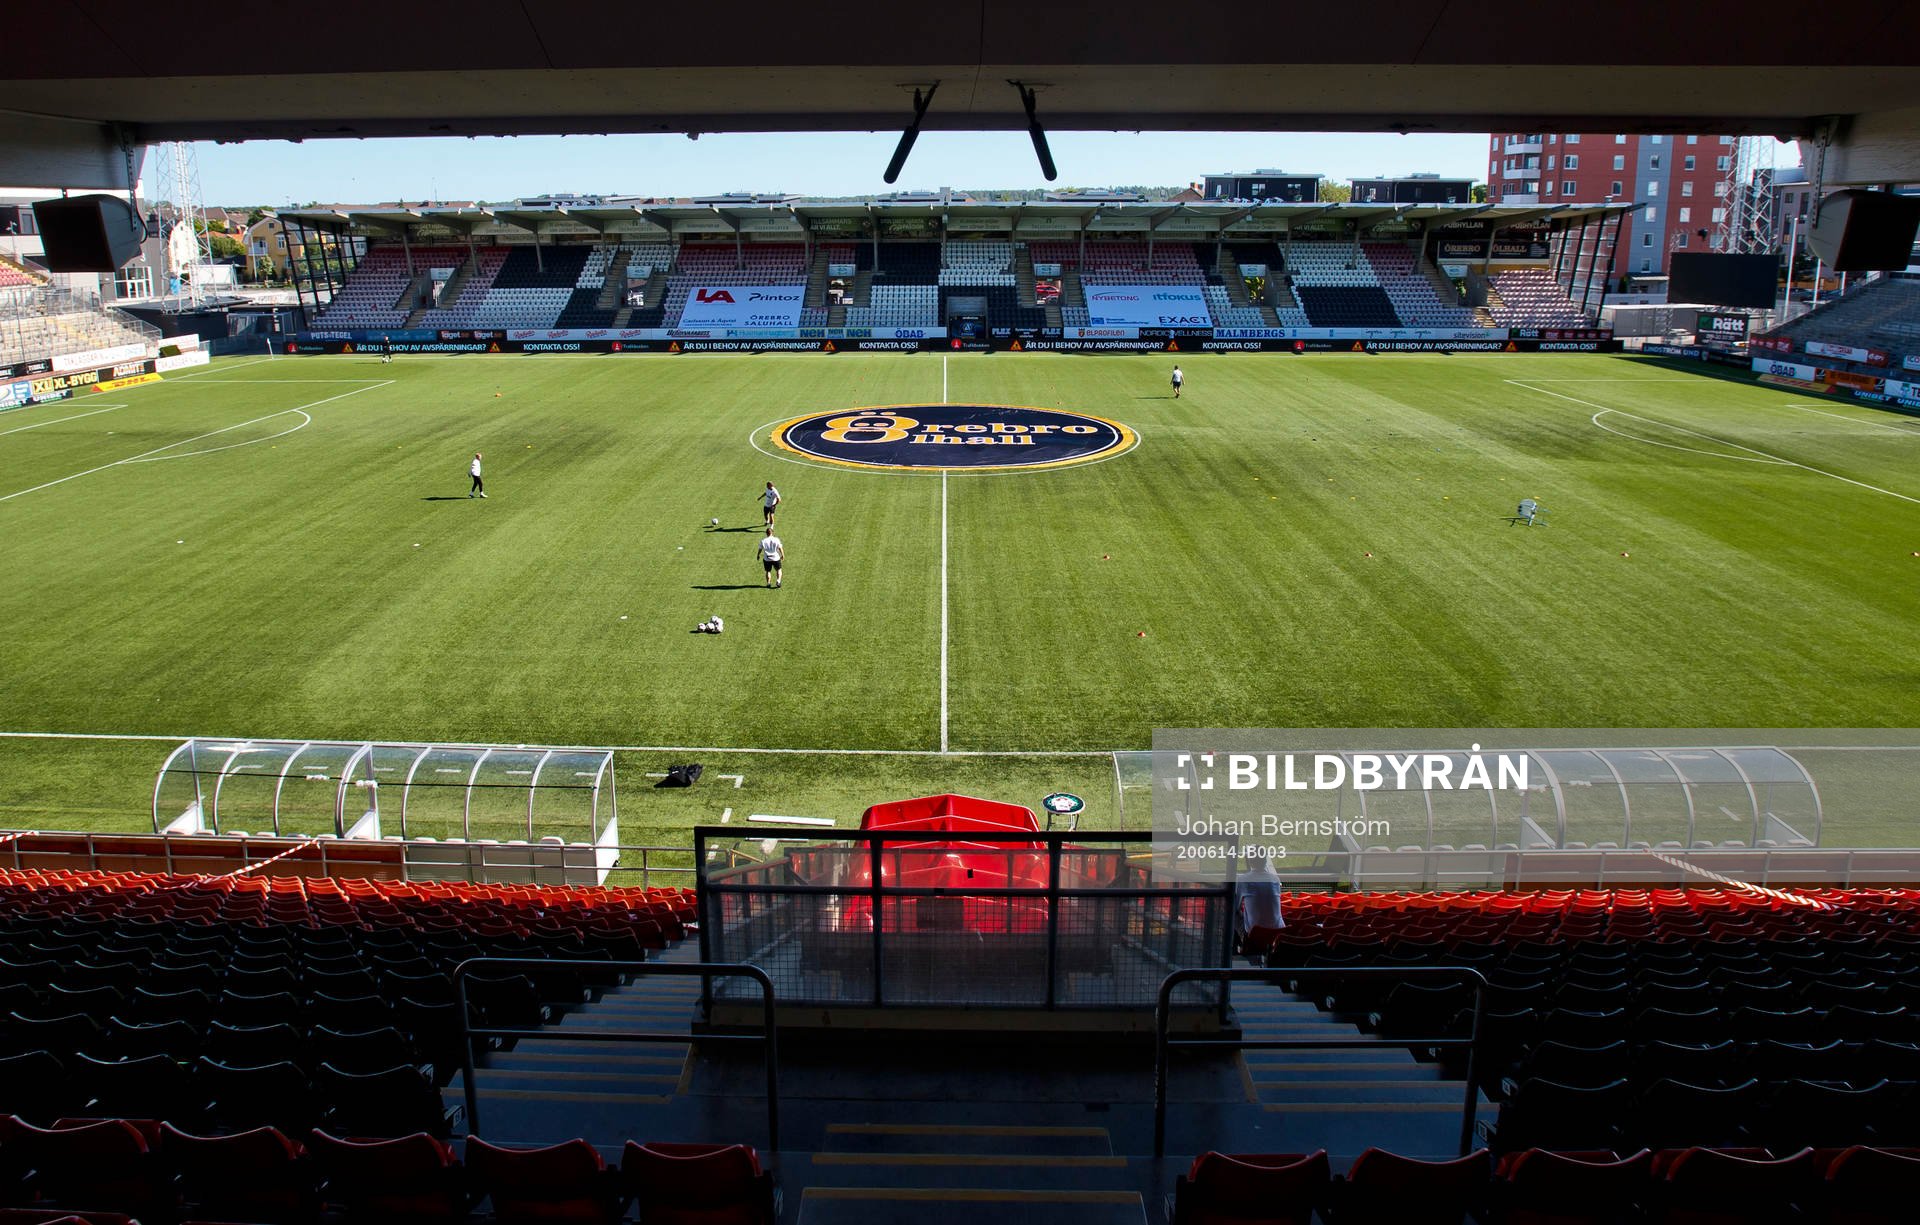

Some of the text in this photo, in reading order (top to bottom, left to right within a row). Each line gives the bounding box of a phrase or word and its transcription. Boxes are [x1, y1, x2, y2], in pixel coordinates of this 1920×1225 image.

[748, 292, 802, 301] Printoz
[1159, 315, 1208, 325] EXACT
[1713, 317, 1744, 331] Rätt
[895, 328, 924, 338] ÖBAB
[1139, 329, 1171, 337] NORDIC
[1216, 329, 1285, 338] MALMBERGS
[356, 343, 367, 351] ÄR
[421, 342, 487, 351] AVSPÄRRNINGAR?
[683, 341, 695, 350] ÄR
[696, 342, 707, 350] DU
[713, 342, 740, 350] BEHOV
[752, 340, 821, 349] AVSPÄRRNINGAR?
[1025, 340, 1037, 349] ÄR
[1038, 341, 1050, 349] DU
[1055, 341, 1083, 349] BEHOV
[1083, 341, 1096, 349] AV
[1096, 340, 1164, 349] AVSPÄRRNINGAR?
[1366, 341, 1378, 350] ÄR
[1378, 342, 1391, 350] DU
[1395, 342, 1422, 350] BEHOV
[1422, 342, 1435, 350] AV
[1435, 341, 1503, 350] AVSPÄRRNINGAR?
[1770, 361, 1796, 377] ÖBAB
[54, 372, 97, 392] XL-BYGG
[1854, 390, 1891, 401] UNIBET
